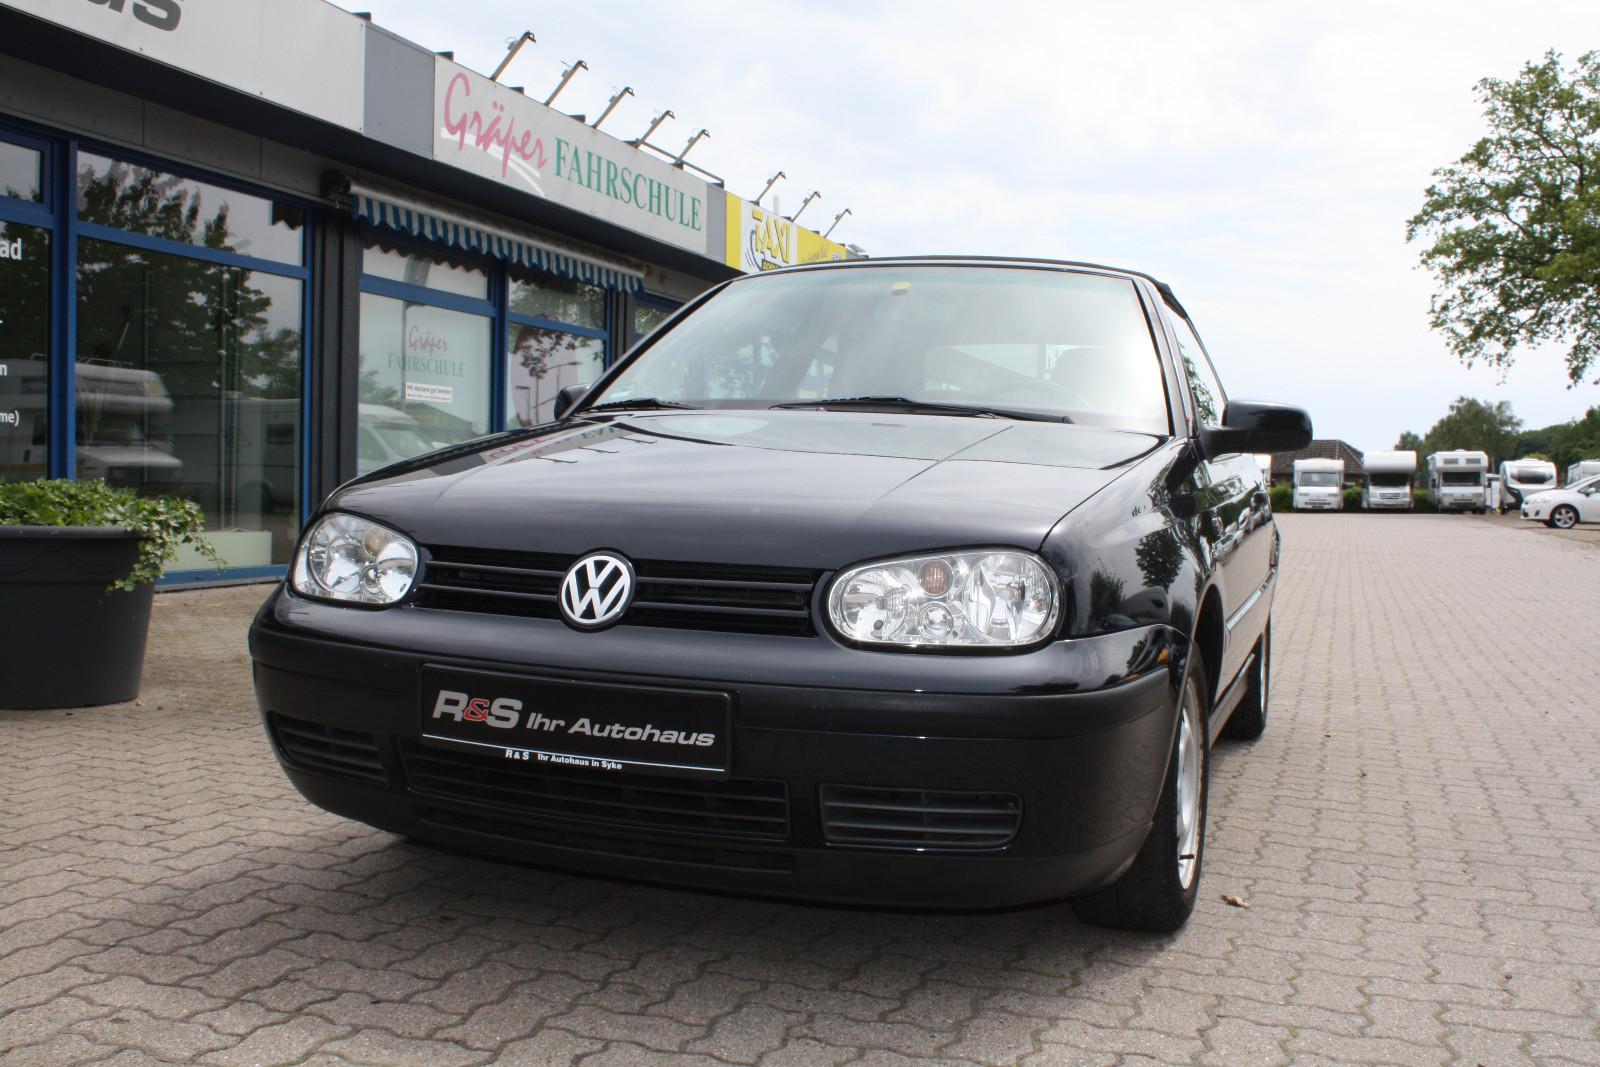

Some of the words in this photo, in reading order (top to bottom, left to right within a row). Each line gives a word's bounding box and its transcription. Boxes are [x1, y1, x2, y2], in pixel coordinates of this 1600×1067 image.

[443, 72, 547, 178] Gräper
[554, 136, 702, 232] FAHRSCHULE
[752, 208, 791, 264] TAXI
[387, 352, 464, 378] FAHRSCHULE
[432, 689, 523, 730] R&S
[526, 712, 566, 732] Ihr
[567, 716, 716, 747] Autohaus
[537, 753, 549, 761] Ihr
[550, 755, 590, 767] Autohaus
[591, 759, 600, 768] in
[601, 760, 623, 771] Syke
